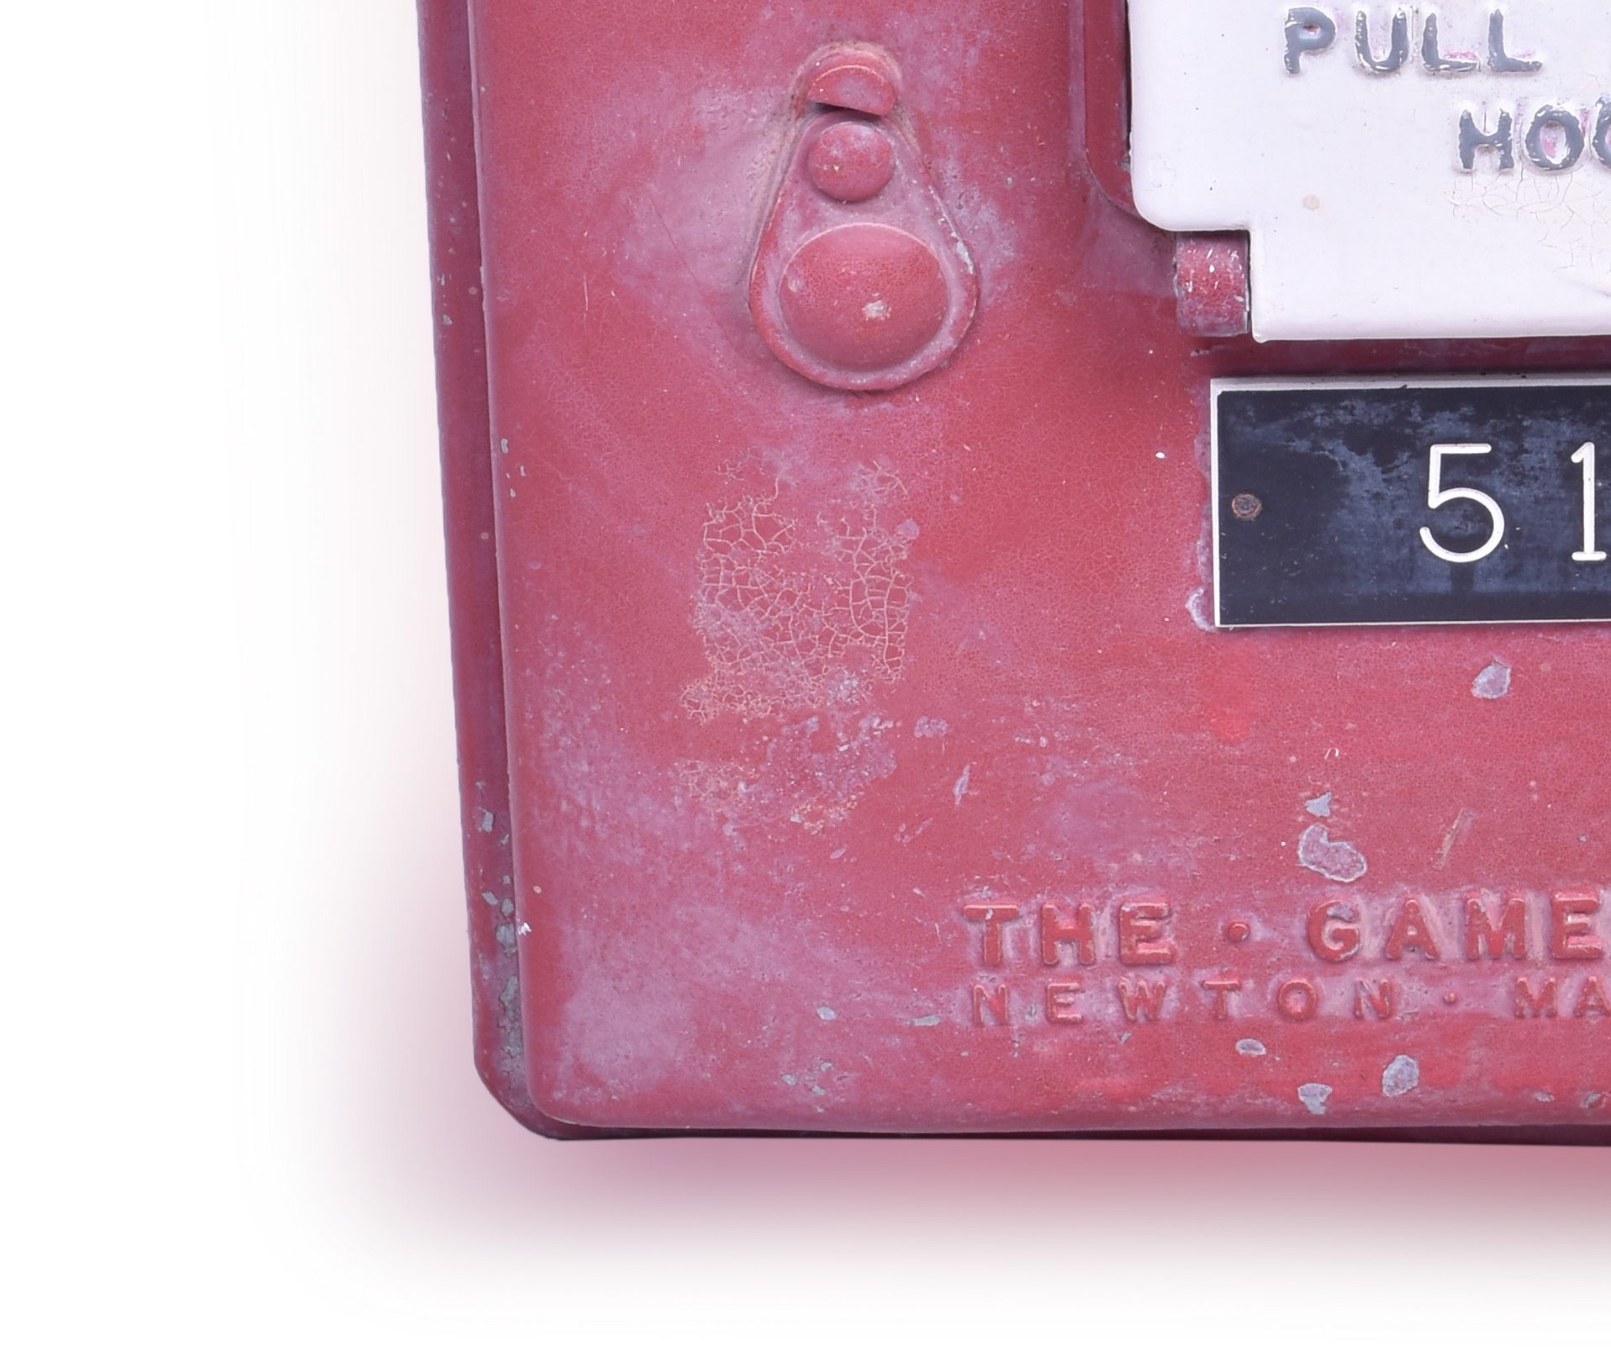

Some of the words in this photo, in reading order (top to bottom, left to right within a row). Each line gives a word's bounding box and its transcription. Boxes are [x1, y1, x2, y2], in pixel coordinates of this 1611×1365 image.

[1284, 5, 1543, 73] PULL
[961, 896, 1177, 966] THE
[971, 978, 1397, 1024] NEWTON
